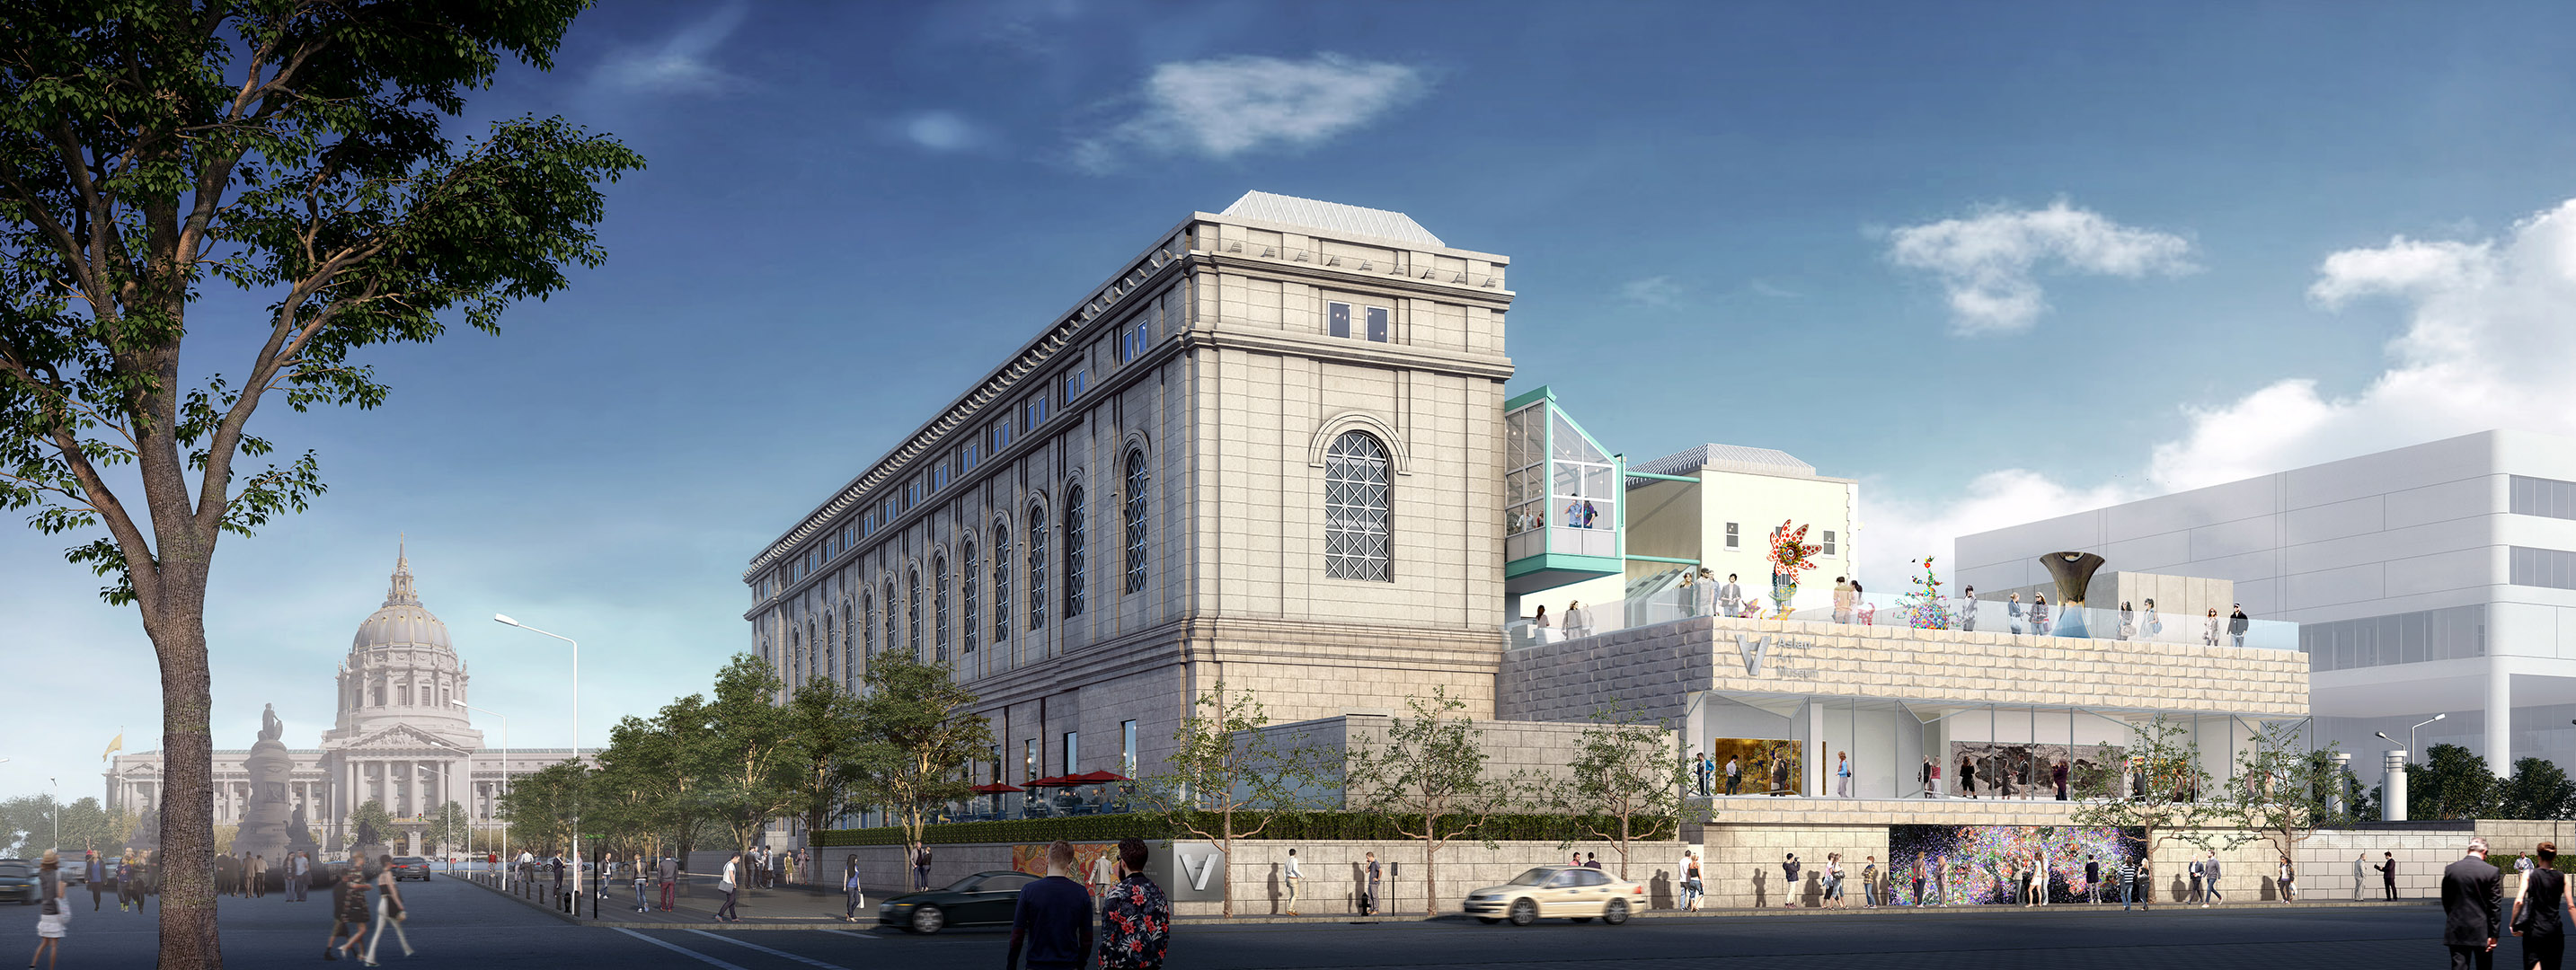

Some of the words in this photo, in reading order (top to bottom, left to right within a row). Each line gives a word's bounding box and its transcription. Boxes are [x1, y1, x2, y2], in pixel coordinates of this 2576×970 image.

[1776, 638, 1811, 650] Asian
[1776, 652, 1793, 664] Art
[1776, 666, 1819, 679] Museum
